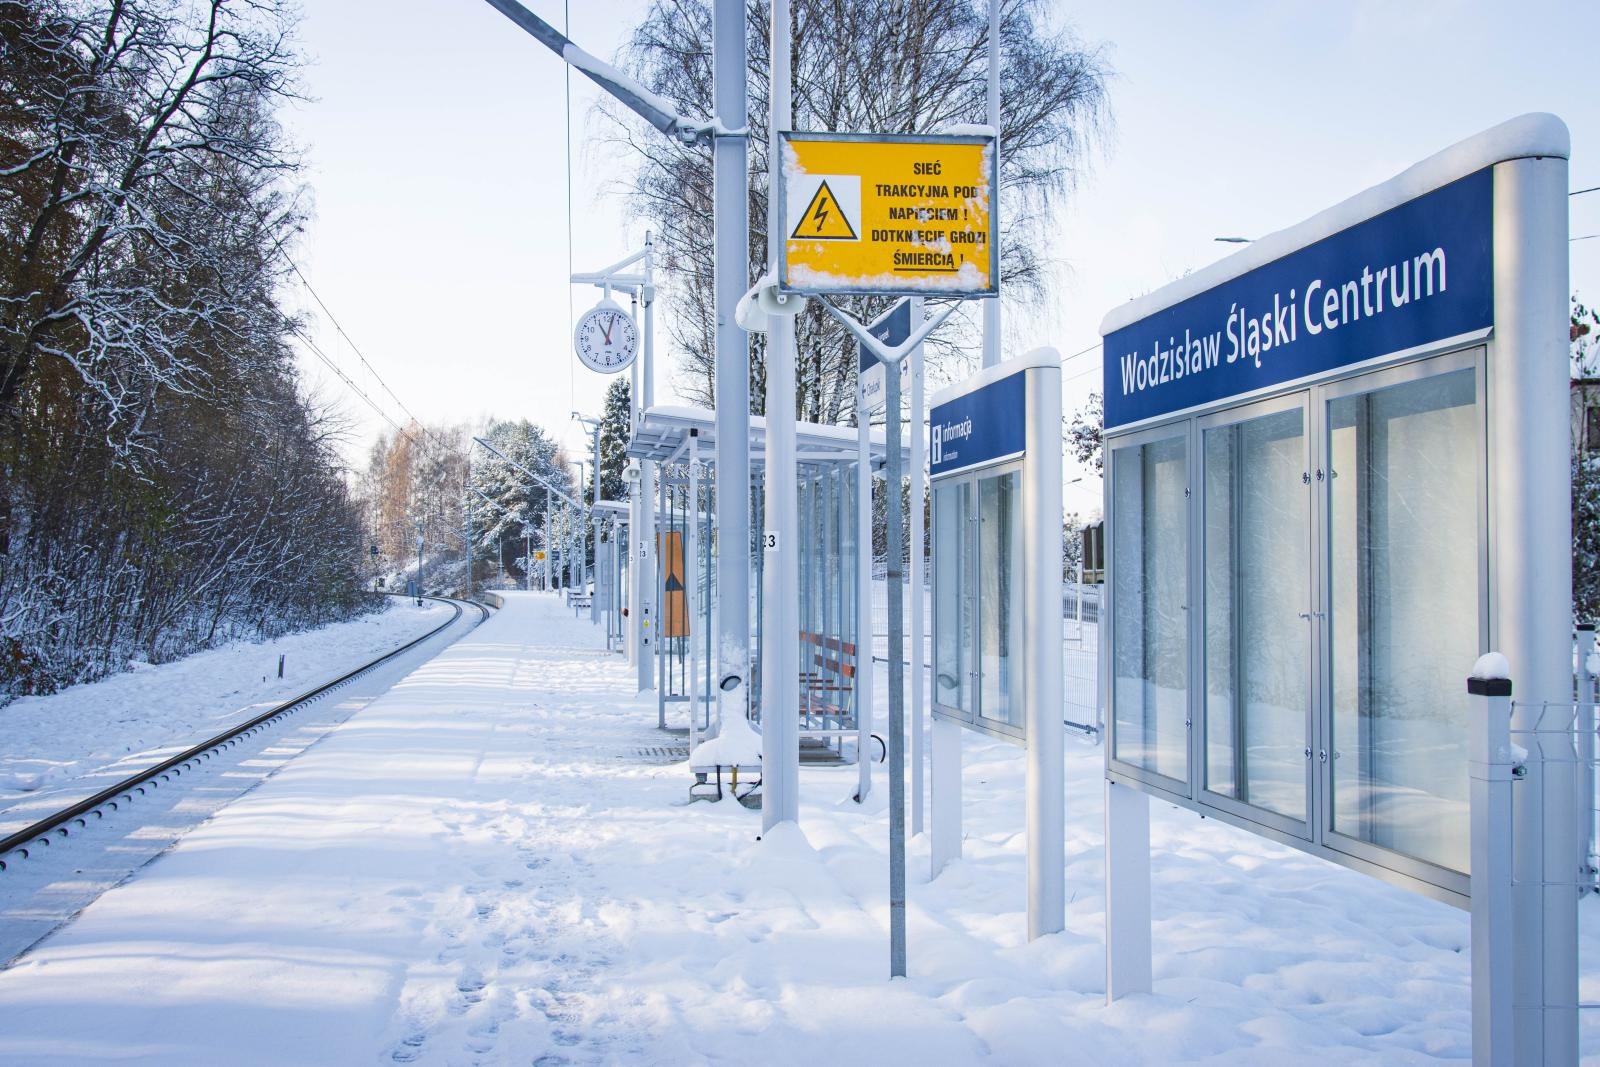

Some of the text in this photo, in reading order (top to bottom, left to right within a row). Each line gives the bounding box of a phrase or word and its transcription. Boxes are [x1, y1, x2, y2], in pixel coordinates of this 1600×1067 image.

[913, 160, 942, 175] SIEĆ
[875, 184, 978, 199] TRAKCYJNA POD
[871, 230, 945, 245] DOTKNĘCIE
[893, 249, 955, 268] ŚMIERCIĄ
[1120, 246, 1447, 396] Wodzisław Śląski Centrum
[943, 416, 972, 442] informacja
